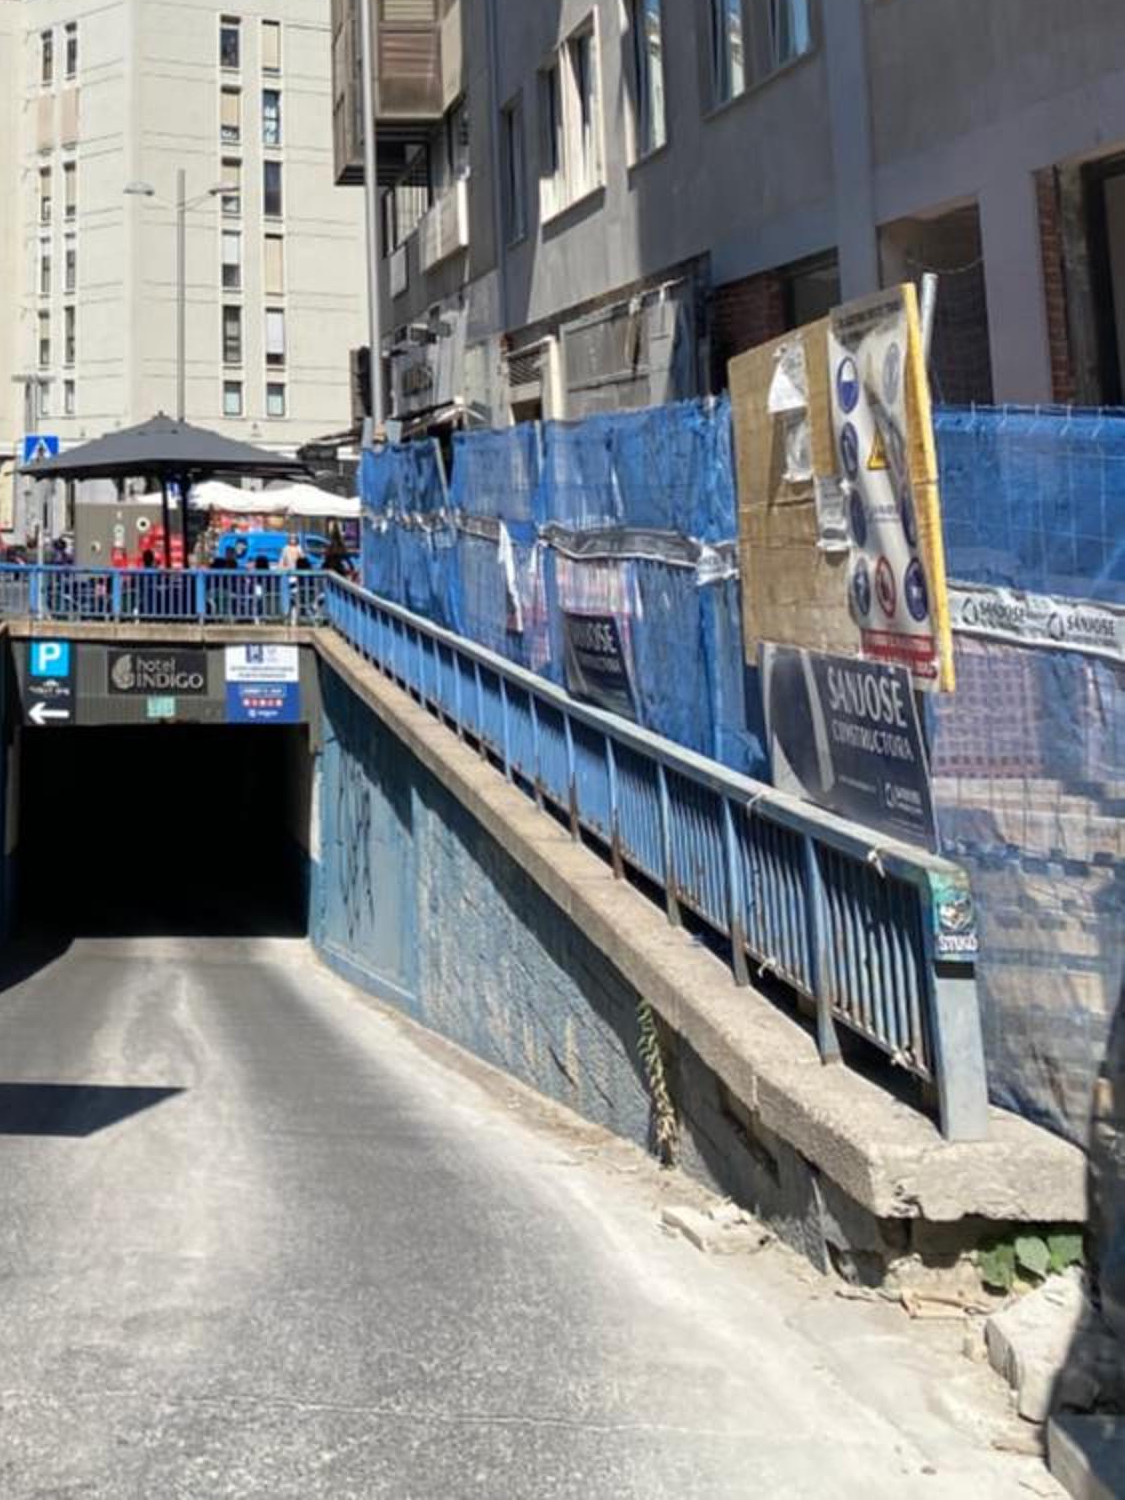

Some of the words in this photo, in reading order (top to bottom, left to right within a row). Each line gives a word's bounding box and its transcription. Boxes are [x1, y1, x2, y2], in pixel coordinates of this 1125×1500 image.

[39, 642, 60, 671] P
[137, 655, 175, 672] hotel
[137, 673, 204, 689] INDIGO
